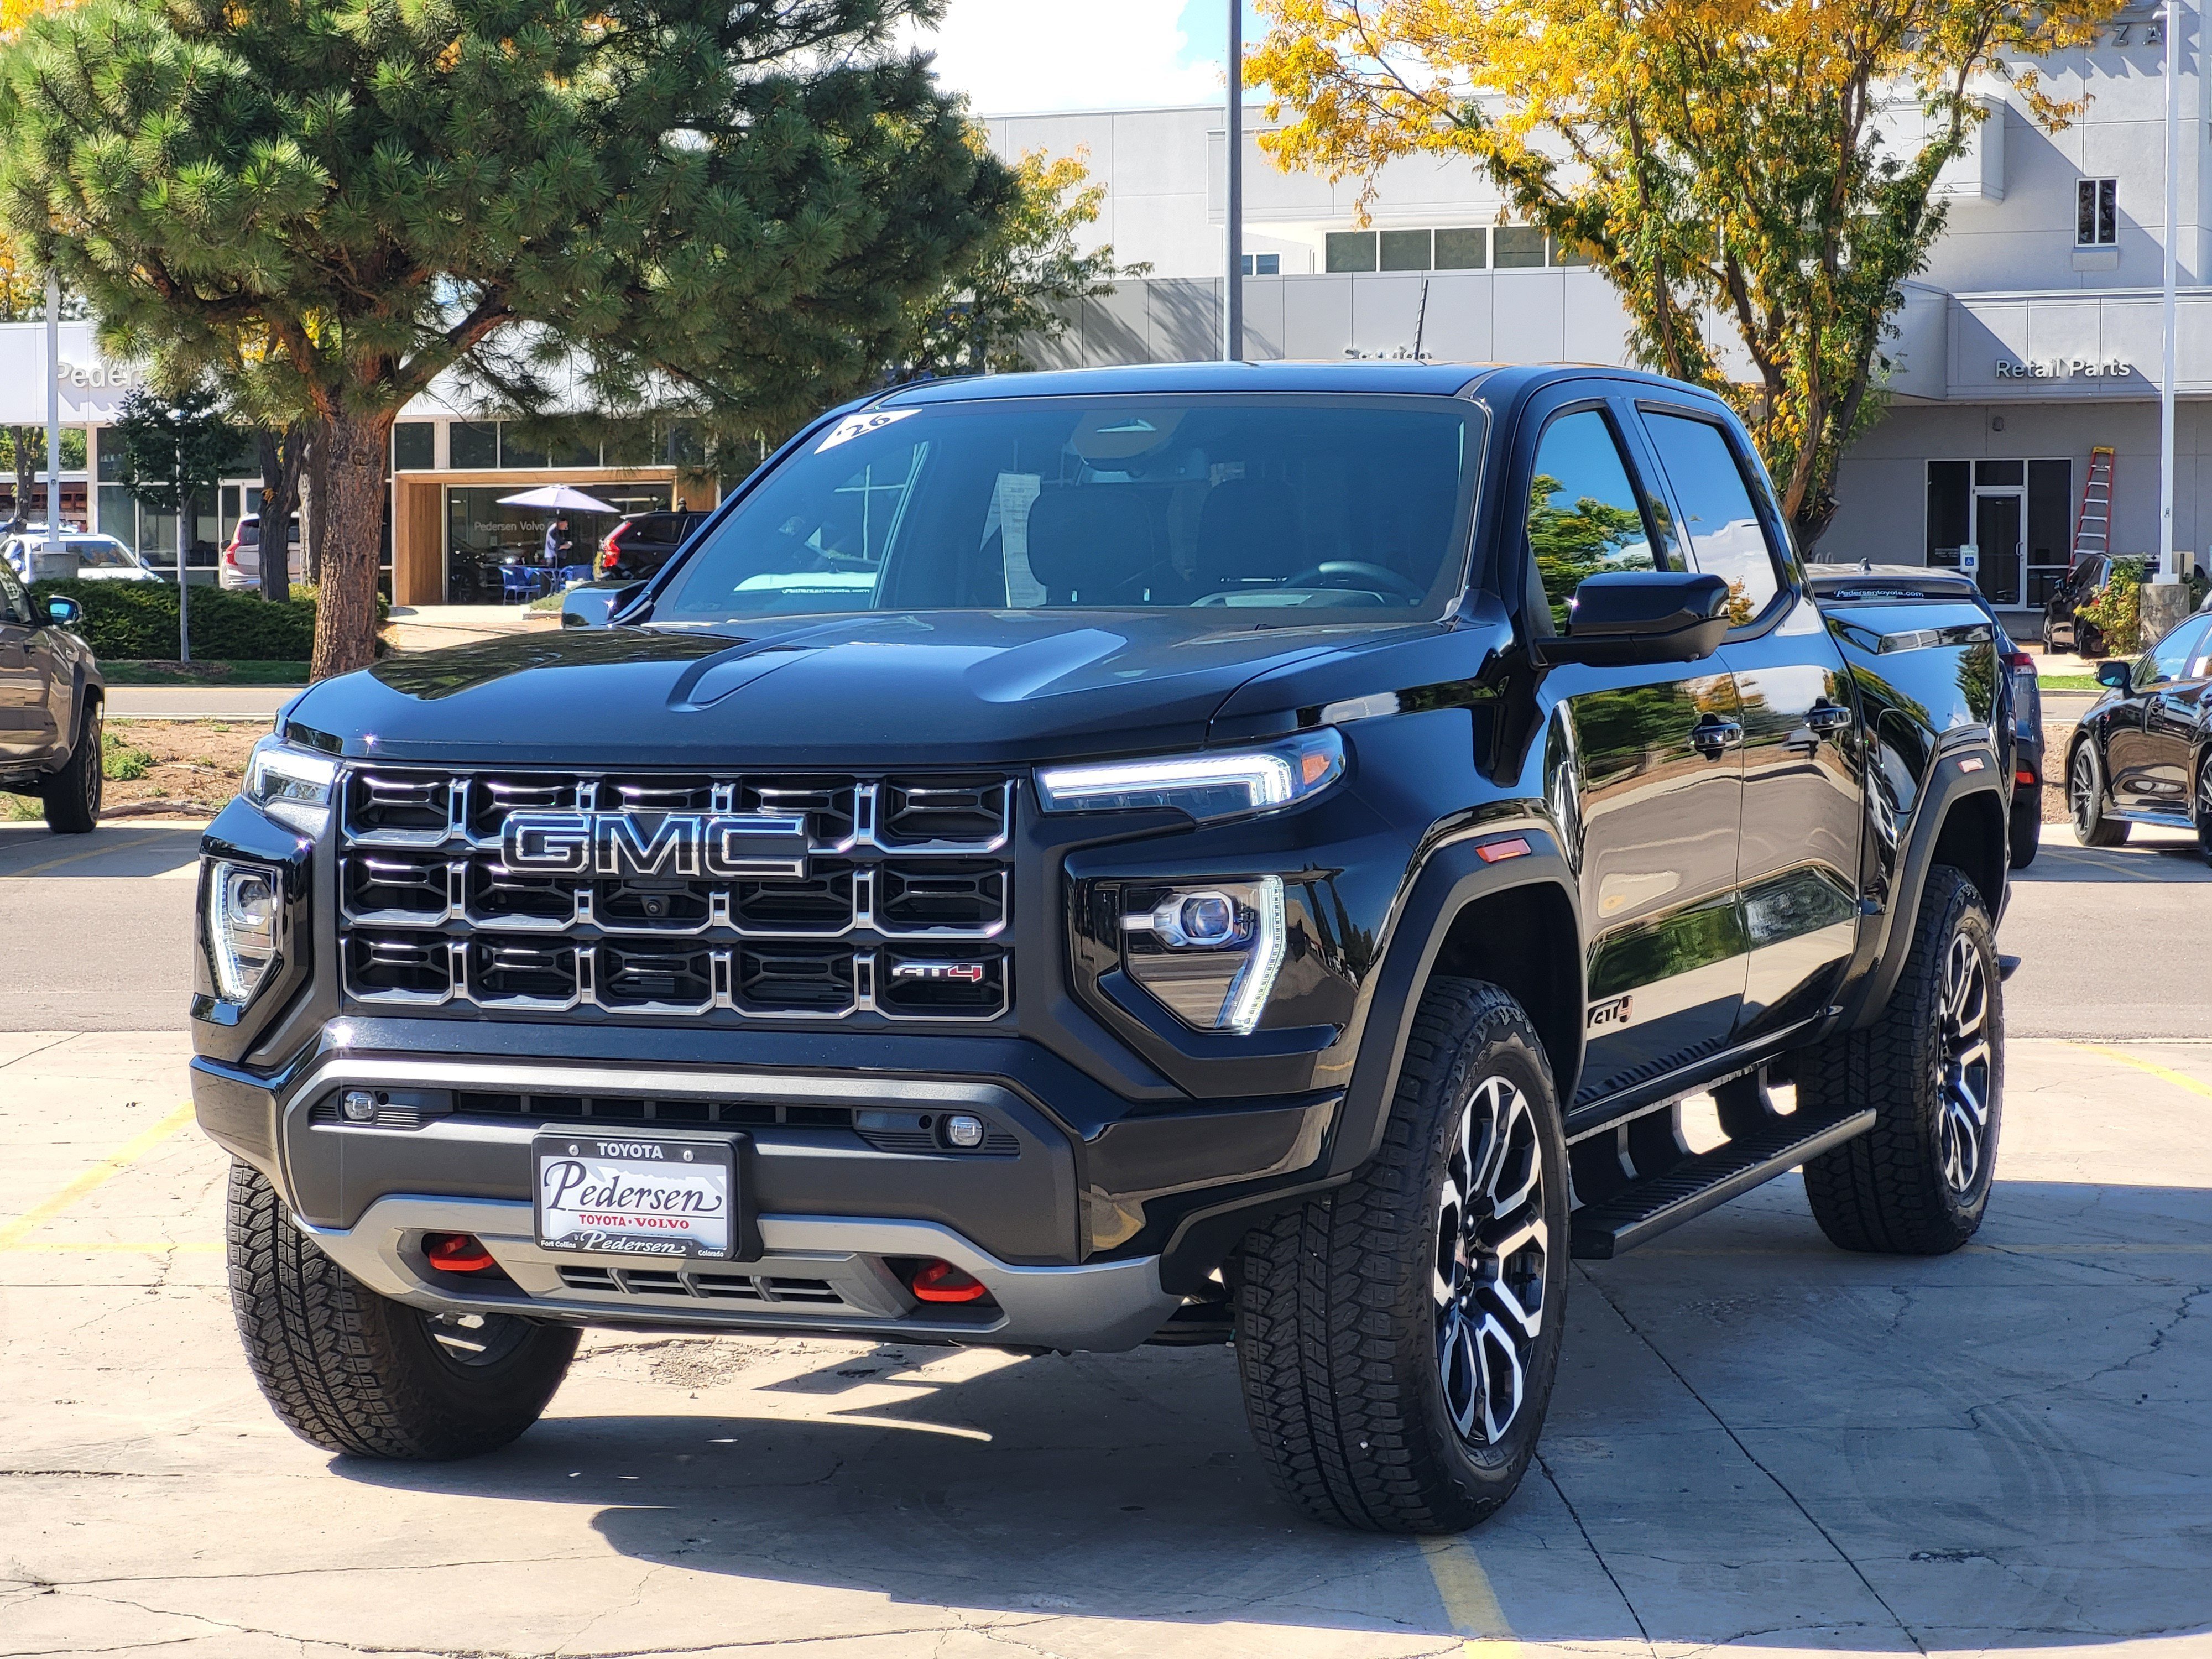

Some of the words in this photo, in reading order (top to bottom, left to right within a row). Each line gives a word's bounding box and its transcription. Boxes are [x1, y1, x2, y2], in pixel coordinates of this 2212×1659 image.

[1996, 358, 2060, 378] Retail
[2069, 358, 2131, 377] Parts
[474, 521, 517, 531] Pedersen
[519, 521, 545, 531] Volvo
[500, 811, 805, 878] GMC
[892, 963, 984, 983] AT4
[597, 1142, 664, 1159] TOYOTA
[544, 1161, 722, 1212] Pedersen
[579, 1214, 626, 1227] TOYOTA
[635, 1217, 690, 1229] VOLVO
[555, 1240, 576, 1249] Collins
[580, 1229, 687, 1254] Pedersen
[698, 1249, 724, 1258] Colorado
